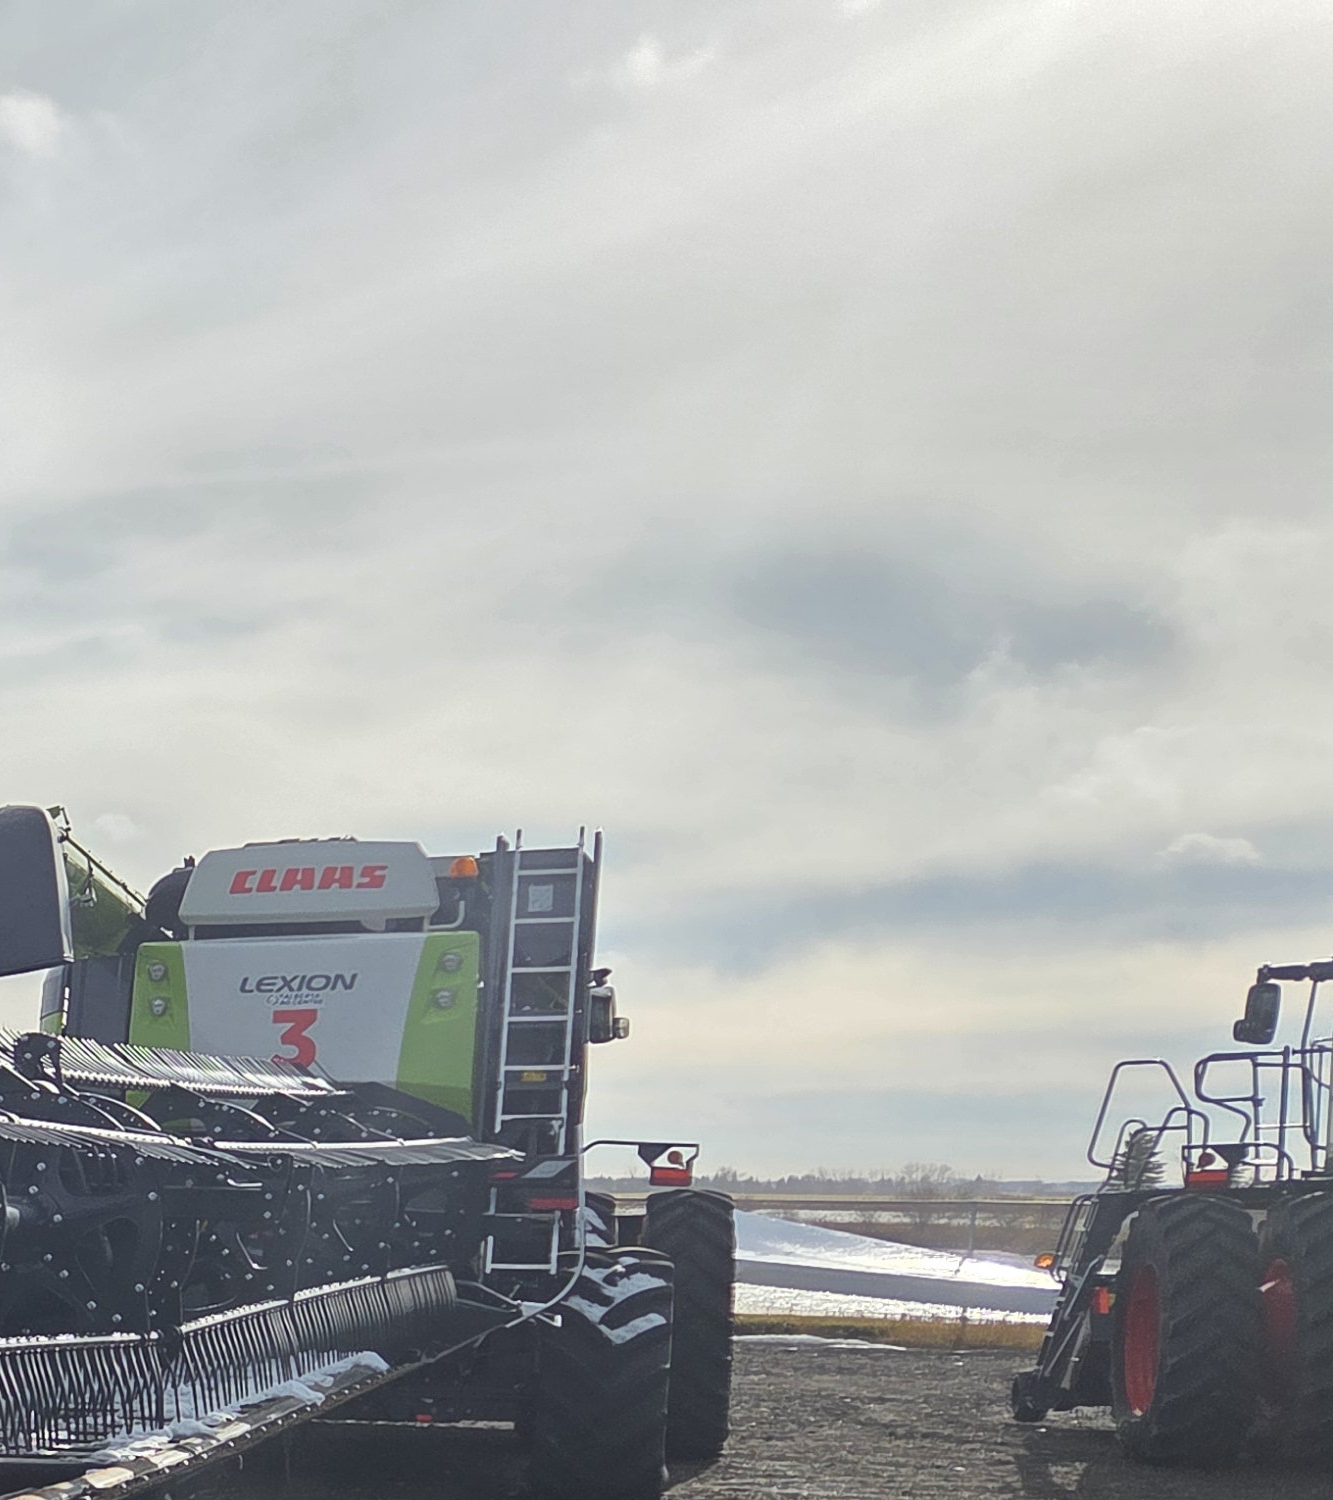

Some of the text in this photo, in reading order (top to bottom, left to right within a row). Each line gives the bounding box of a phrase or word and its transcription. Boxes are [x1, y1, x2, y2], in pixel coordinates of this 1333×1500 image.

[229, 865, 388, 895] CLAAS
[239, 972, 358, 993] LEXION
[271, 1008, 317, 1070] 3
